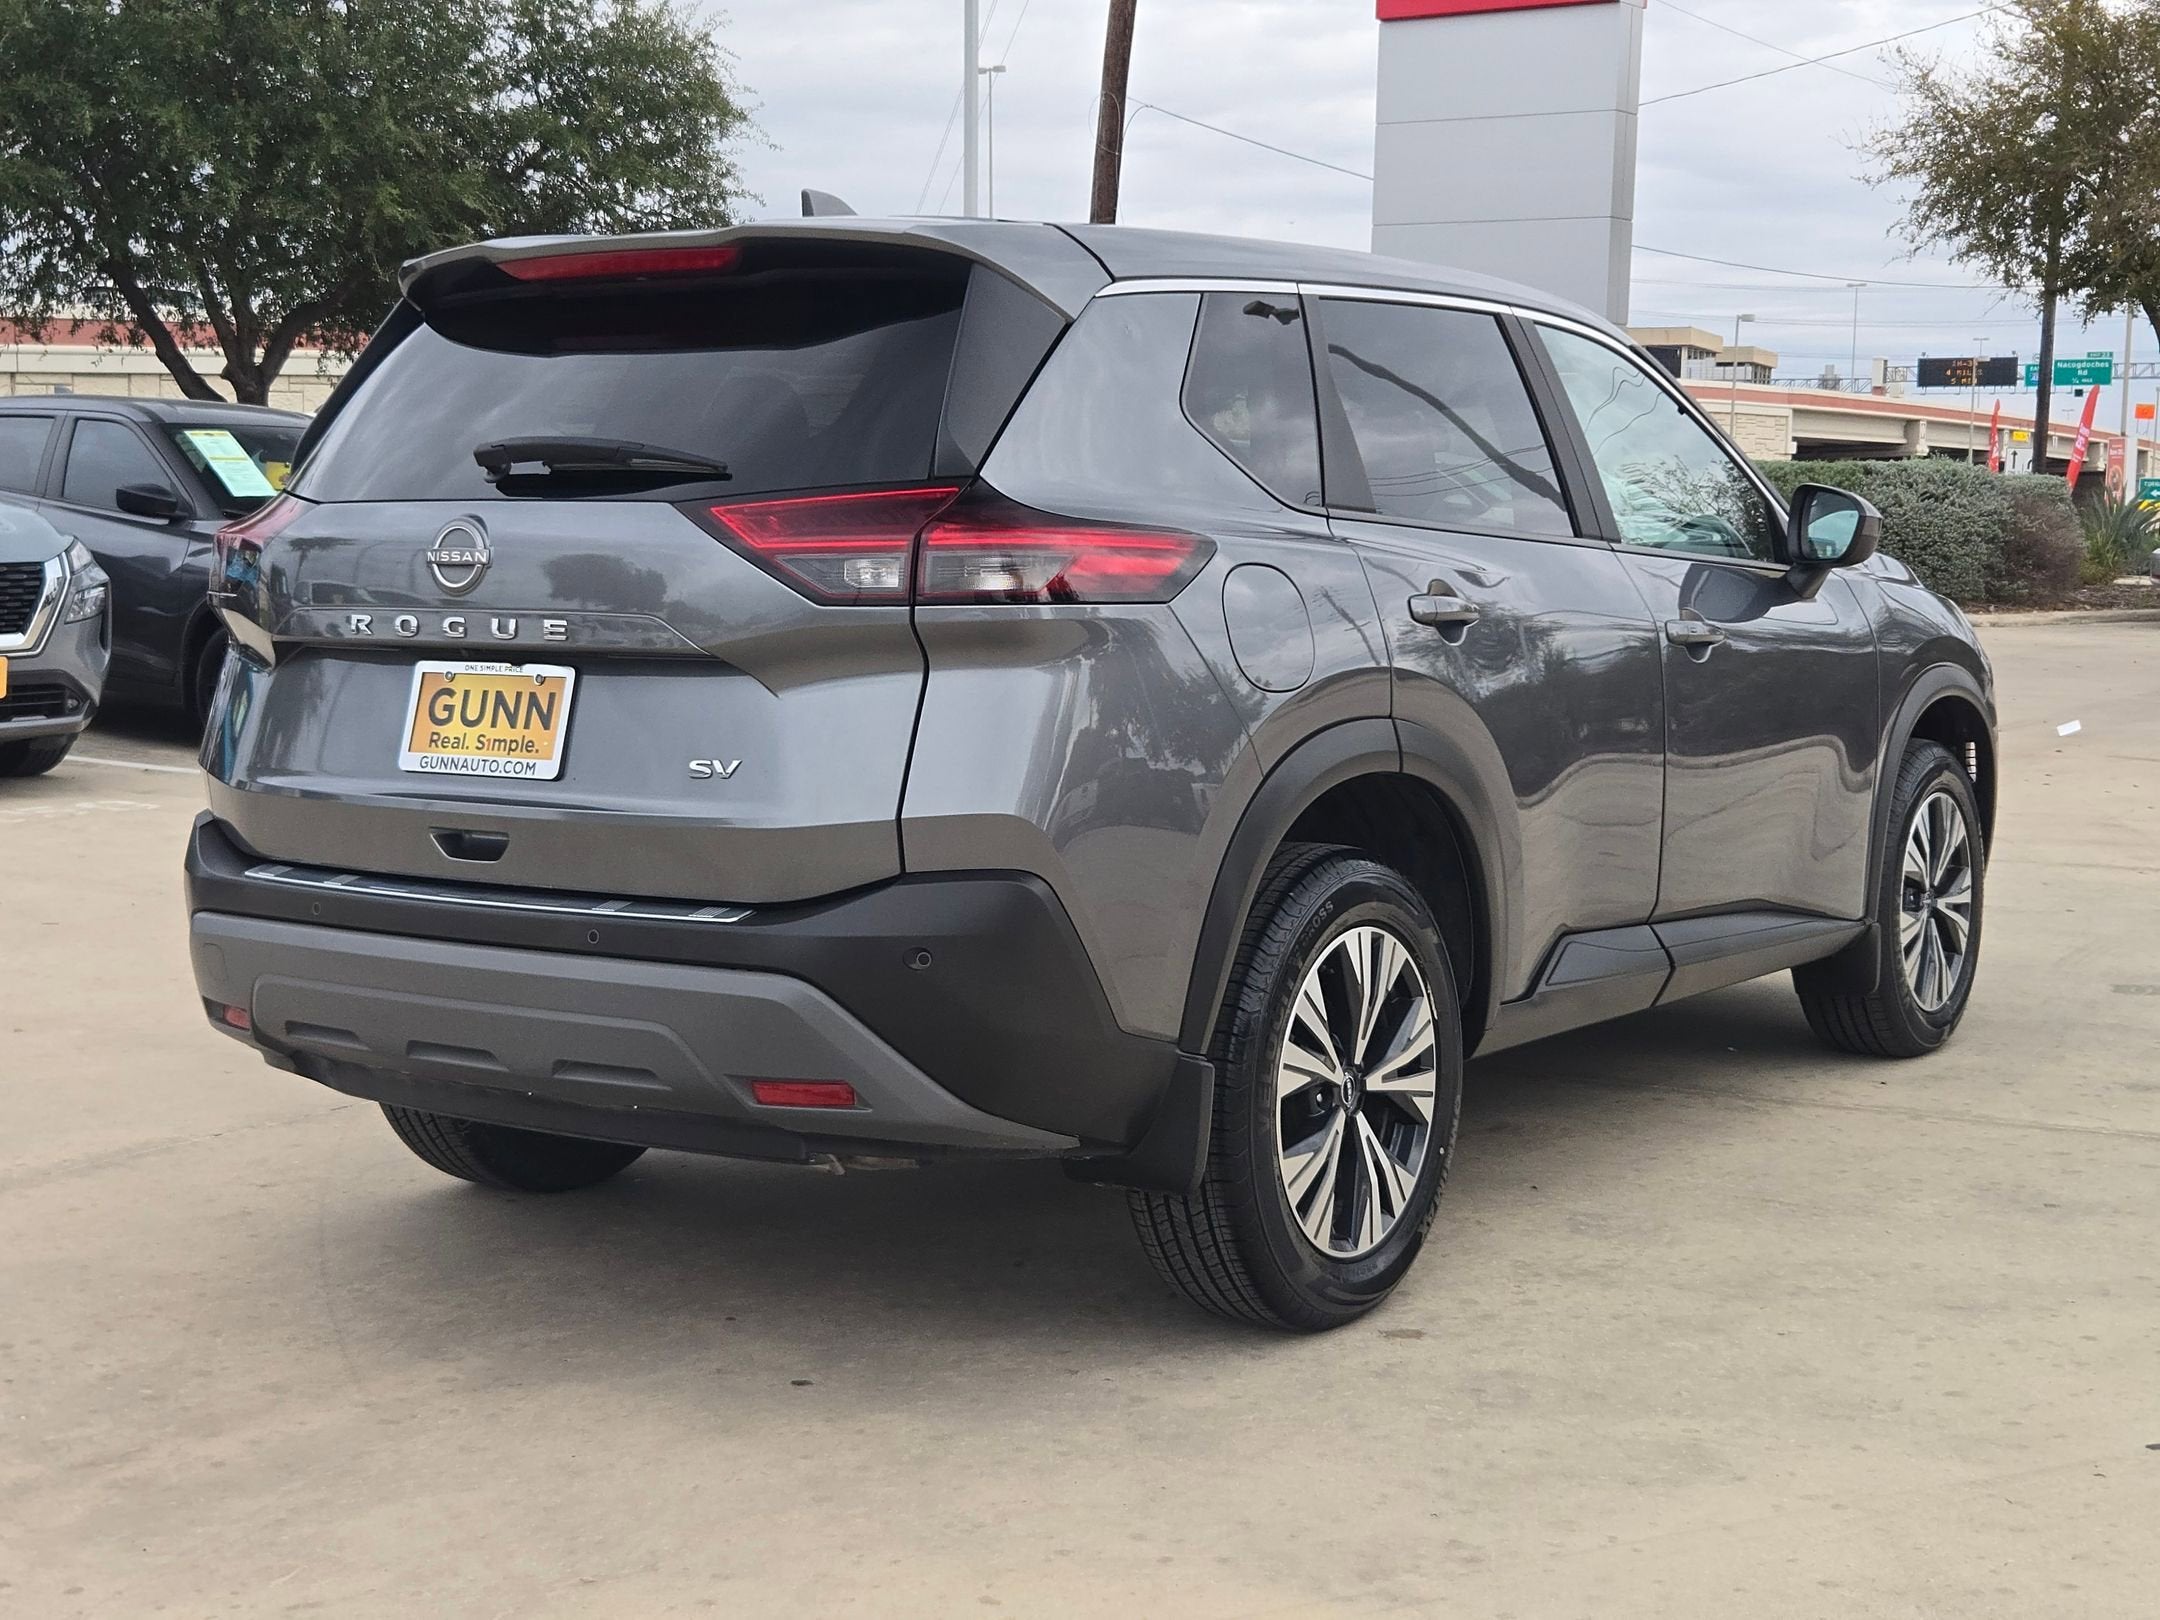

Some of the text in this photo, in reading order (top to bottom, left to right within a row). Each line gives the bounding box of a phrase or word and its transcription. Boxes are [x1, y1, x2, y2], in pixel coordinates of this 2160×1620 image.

[427, 550, 488, 563] NISSAN
[350, 614, 568, 641] ROGUE
[504, 665, 523, 673] PRICE
[428, 687, 557, 731] GUNN
[428, 731, 469, 750] Real.
[419, 755, 537, 776] GUNNAUTO.COM
[688, 759, 743, 780] SV
